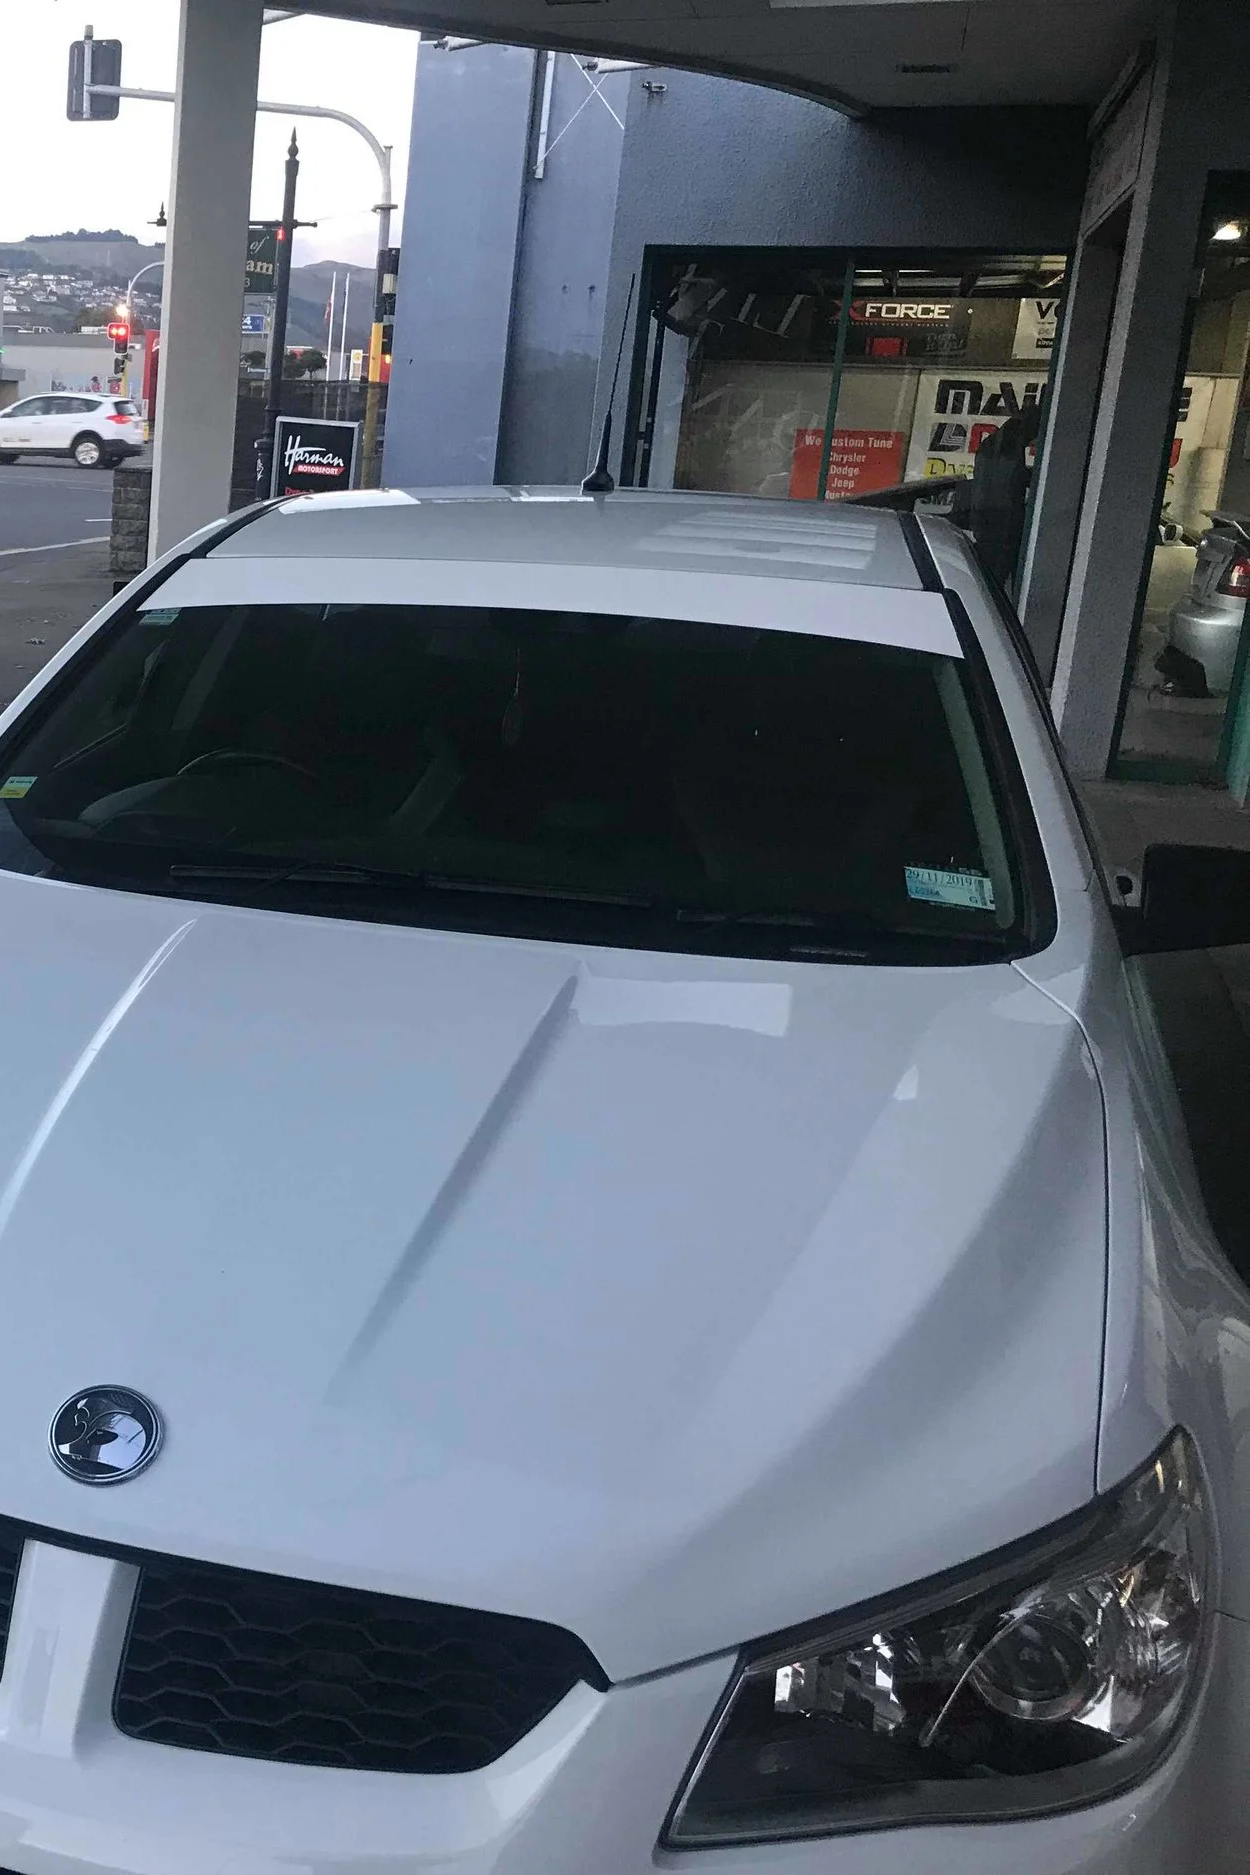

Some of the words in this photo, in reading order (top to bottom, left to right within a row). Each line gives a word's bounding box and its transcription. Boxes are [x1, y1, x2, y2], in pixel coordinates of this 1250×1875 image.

[804, 434, 822, 446] We
[831, 437, 865, 448] ustom
[868, 437, 894, 449] Tune
[284, 434, 345, 476] Harman
[297, 464, 339, 476] MOTORSPORT
[829, 464, 860, 477] Dodge
[831, 478, 855, 490] Jeep
